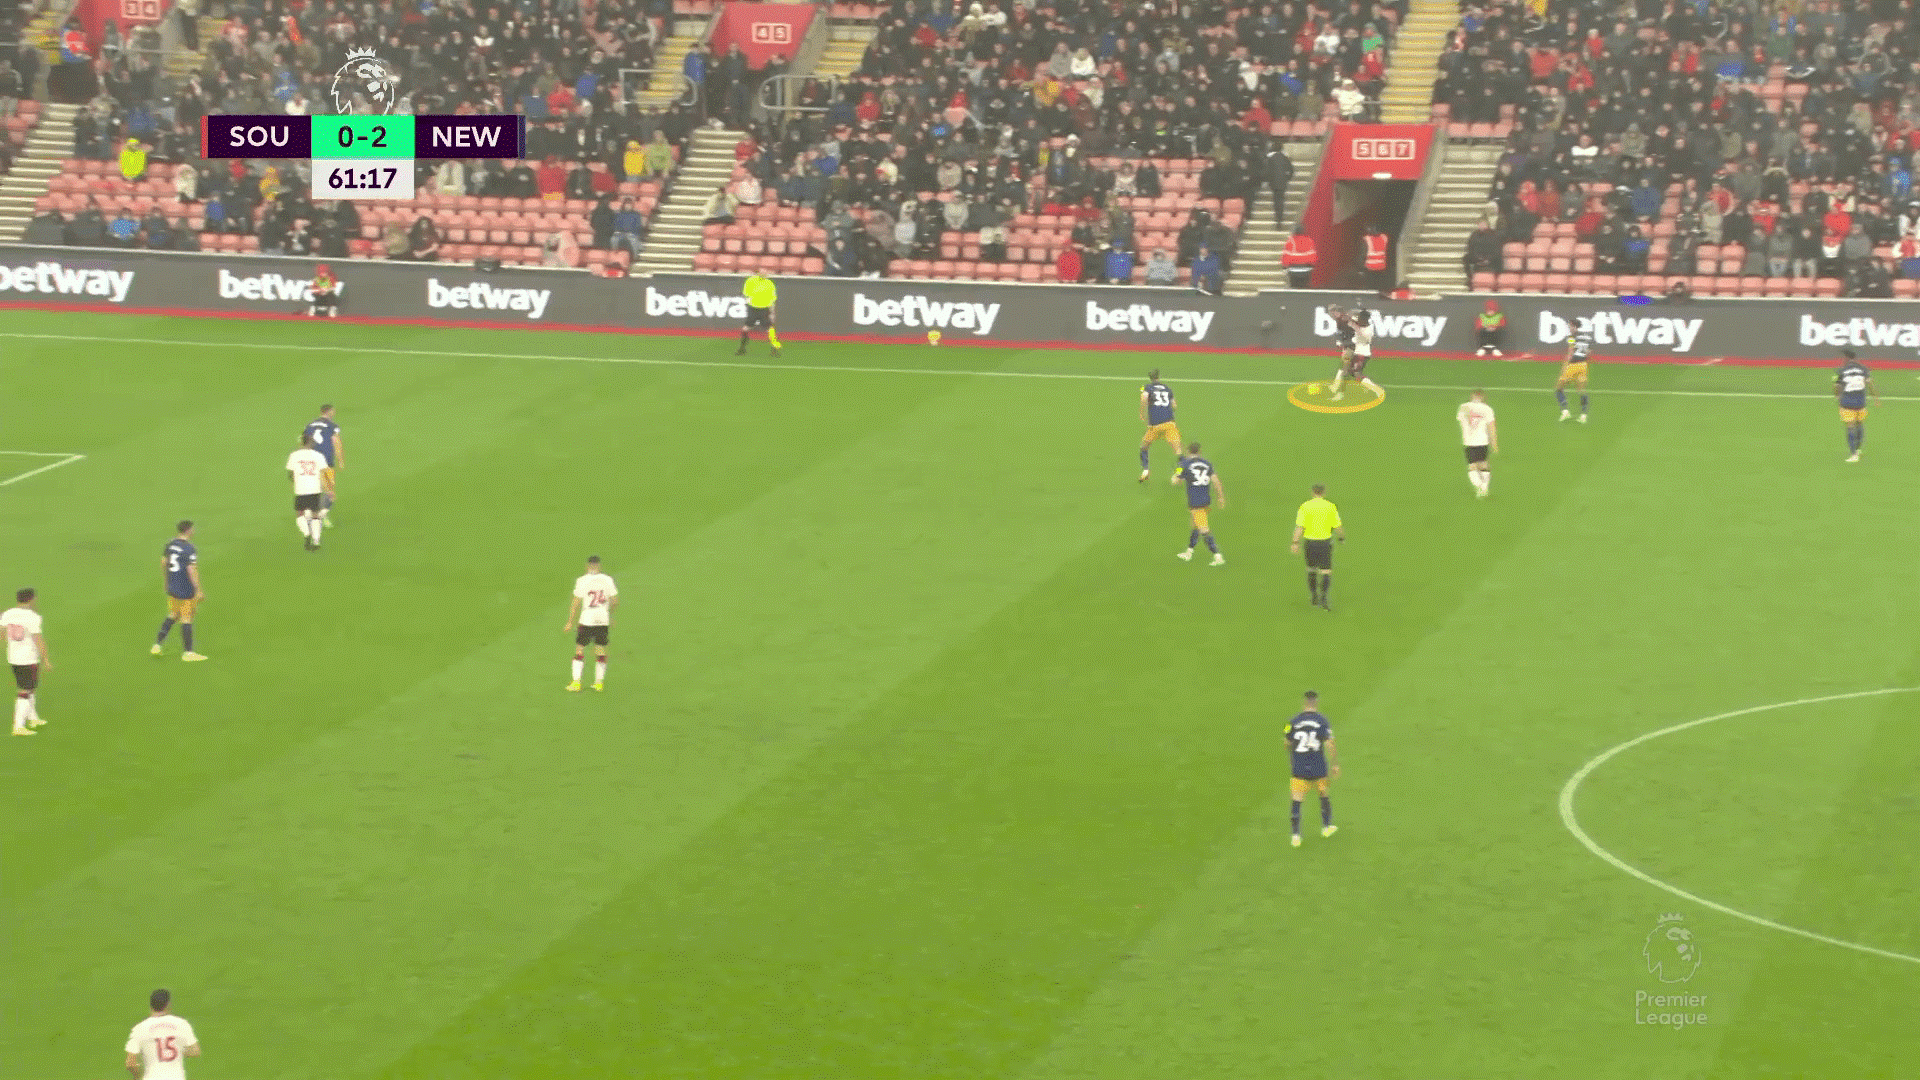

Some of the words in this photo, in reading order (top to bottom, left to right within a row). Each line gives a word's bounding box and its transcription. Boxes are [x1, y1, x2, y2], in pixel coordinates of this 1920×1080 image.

[219, 269, 344, 302] betwa
[428, 279, 550, 319] betway
[645, 286, 748, 318] betwa
[853, 293, 1000, 335] betway
[1085, 301, 1214, 341] betway
[1314, 306, 1448, 347] bway
[1800, 314, 1920, 355] betwa
[1153, 391, 1170, 407] 33
[298, 460, 316, 476] 32
[1191, 469, 1211, 486] 36
[169, 553, 180, 572] 5
[587, 589, 607, 608] 24
[1293, 731, 1321, 753] 24
[154, 1035, 178, 1062] 15
